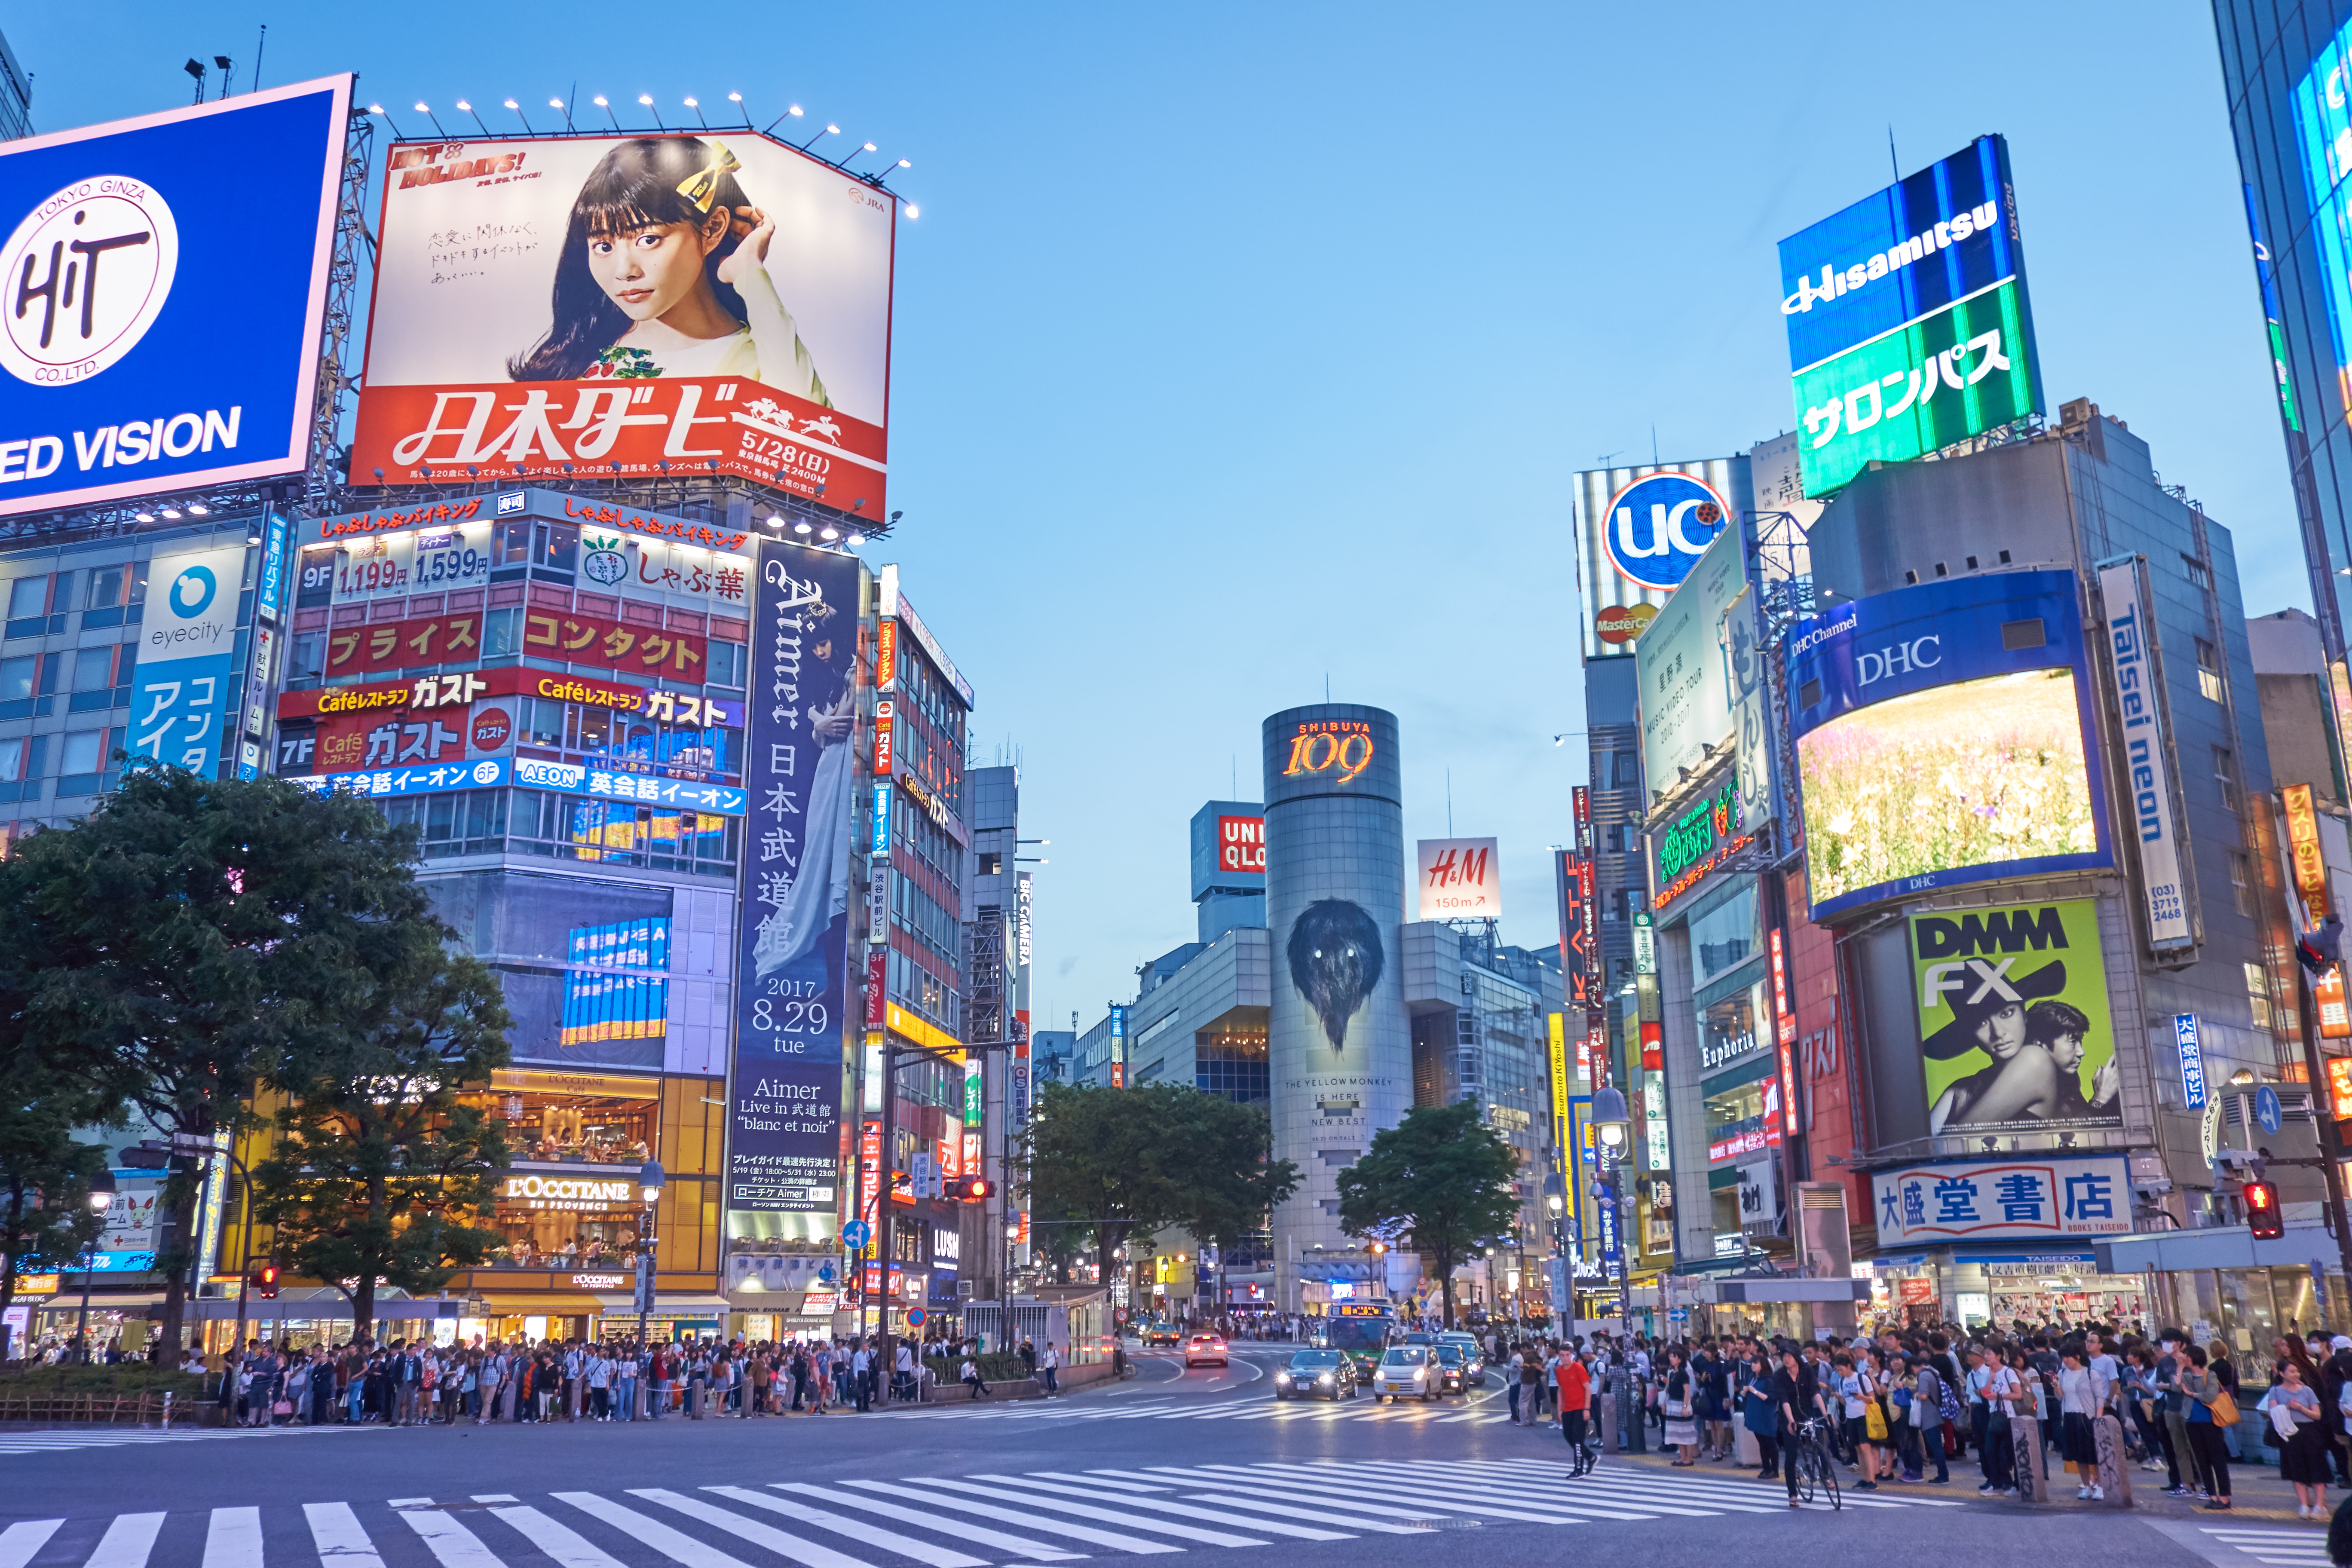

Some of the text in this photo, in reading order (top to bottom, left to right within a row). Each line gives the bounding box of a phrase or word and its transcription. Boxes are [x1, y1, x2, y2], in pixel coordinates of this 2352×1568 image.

[391, 144, 444, 170] HOT
[399, 152, 526, 190] HOLIDAYS!
[34, 179, 146, 221] TOKYO GINZA
[866, 198, 884, 212] JRA
[1781, 199, 1998, 315] Hisamitsu
[1804, 328, 2011, 450] サロンパス
[74, 405, 242, 472] VISION
[741, 430, 830, 474] 5/28(日)
[320, 498, 483, 538] しゃぶしゃぶバイキング
[499, 494, 523, 511] 寿司
[565, 497, 747, 550] しゃぶしゃぶバイキング
[358, 544, 383, 556] ランチ
[420, 536, 450, 549] ディナー
[263, 527, 282, 602] 東急リバブル
[303, 566, 332, 588] 9F
[639, 552, 744, 600] しゃぶ葉
[263, 607, 273, 616] 9F
[152, 621, 224, 649] eyecity
[331, 619, 476, 666] プライス
[526, 615, 701, 670] コンタクト
[1792, 614, 1858, 658] DHC Channel
[882, 622, 892, 683] プライス コンタクト
[1856, 635, 1941, 687] DHC
[250, 652, 268, 720] 献血ルーム
[412, 673, 486, 709] ガスト
[1647, 667, 1703, 736] MUSIC VIDEO TOUR
[645, 692, 727, 727] ガスト
[2111, 603, 2162, 844] Taisei neon
[249, 723, 258, 732] 6F
[323, 732, 363, 754] Café
[365, 721, 458, 766] ガスト
[476, 726, 507, 740] ガスト
[1299, 722, 1370, 734] SHIBUYA
[282, 739, 315, 765] 7F
[878, 732, 890, 768] ガスト
[1283, 732, 1374, 783] 109
[476, 766, 495, 781] 6F
[522, 764, 577, 786] AEON
[590, 772, 742, 808] 英会話イーオン
[876, 790, 887, 851] 英会話イーオン
[929, 794, 949, 831] ガスト
[754, 743, 800, 953] 日本武道館
[1428, 847, 1488, 888] H&M
[1910, 875, 1936, 889] DHC
[873, 873, 884, 937] 渋谷駅前ビル
[1436, 897, 1472, 908] 150m
[2152, 884, 2175, 897] (03)
[2152, 897, 2179, 910] 3719
[1019, 879, 1031, 967] BIC CAMERA
[2154, 908, 2181, 922] 2468
[1915, 907, 2070, 960] DMM
[870, 953, 885, 962] 5F
[767, 978, 815, 998] 2017
[1924, 957, 2023, 1008] FX
[752, 999, 827, 1035] 8.29
[774, 1036, 805, 1054] tue
[1643, 1040, 1660, 1052] JTB
[1702, 1031, 1755, 1068] Euphoria
[2179, 1019, 2203, 1105] 大盛堂商事ビル
[567, 1085, 585, 1094] Café
[753, 1078, 821, 1100] Aimer
[967, 1086, 976, 1111] レイク
[1305, 1078, 1347, 1087] YELLOW
[1350, 1078, 1393, 1086] MONKEY
[740, 1100, 831, 1118] Live in 武道館
[784, 1119, 798, 1132] et
[919, 1156, 927, 1195] 渋谷駅前
[941, 1147, 957, 1172] アコム
[507, 1176, 630, 1200] L'OCCITANE
[738, 1187, 804, 1199] ローチケ Aimer
[812, 1190, 830, 1199] 検索
[1881, 1173, 2113, 1230] 大盛堂書店
[530, 1200, 608, 1211] EN PROVENCE
[1602, 1210, 1614, 1253] みずほ銀行
[2067, 1222, 2129, 1232] BOOKS TAISEIDO
[934, 1229, 959, 1260] LUSH
[573, 1274, 624, 1286] L'OCCITANE
